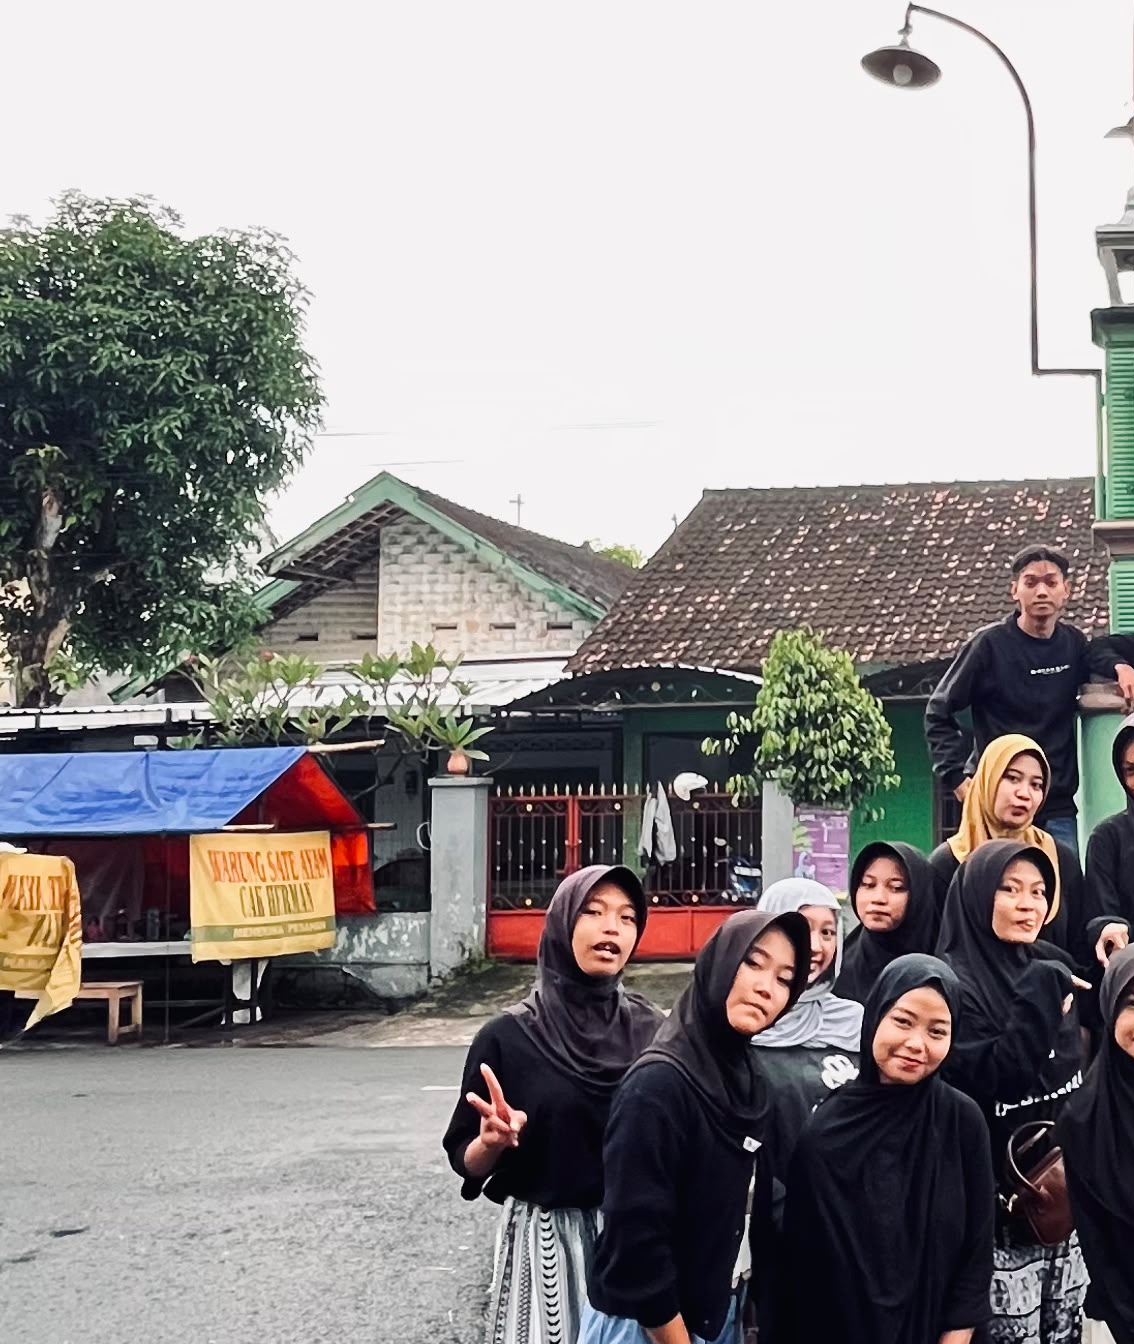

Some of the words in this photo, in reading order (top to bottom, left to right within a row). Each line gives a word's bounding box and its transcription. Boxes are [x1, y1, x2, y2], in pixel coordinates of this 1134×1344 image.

[208, 849, 266, 883] WARUNG
[267, 850, 299, 882] SATE
[300, 847, 330, 880] AYAM
[239, 885, 265, 918] CAK
